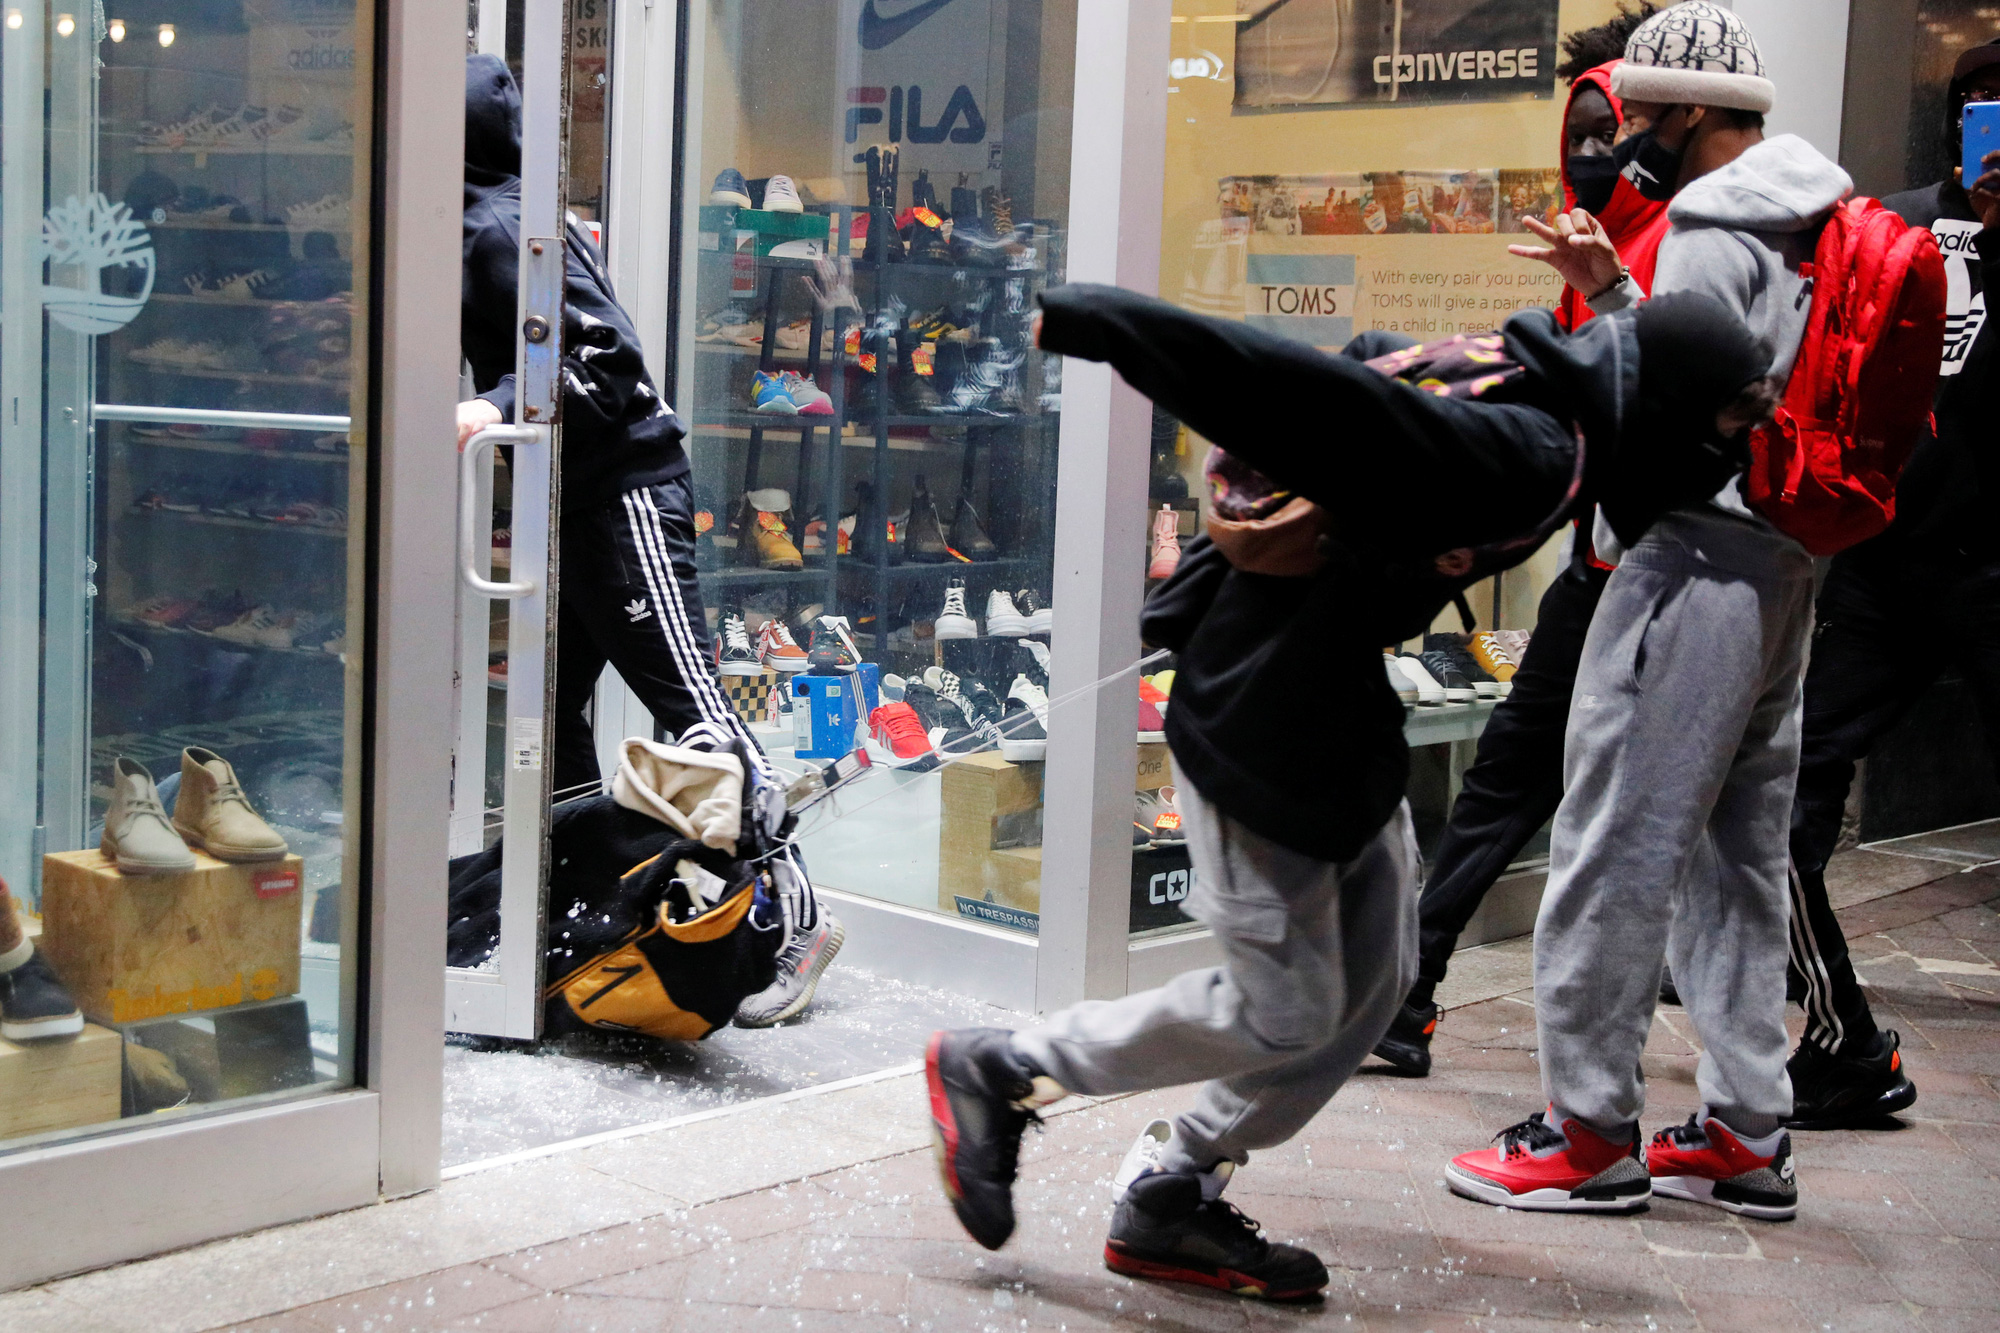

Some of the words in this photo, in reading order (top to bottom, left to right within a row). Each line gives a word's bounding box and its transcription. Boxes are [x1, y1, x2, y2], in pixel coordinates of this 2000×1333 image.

[1373, 48, 1538, 83] CONVERSE
[844, 85, 987, 144] FILA
[1372, 270, 1405, 285] With
[1409, 273, 1448, 287] every
[1453, 272, 1481, 288] pair
[1486, 274, 1513, 288] you
[1261, 286, 1337, 315] TOMS
[1371, 293, 1413, 308] TOMS
[1417, 295, 1441, 309] will
[1445, 296, 1475, 312] give
[1479, 298, 1488, 310] a
[1493, 296, 1522, 311] pair
[1526, 295, 1543, 308] of
[1546, 298, 1561, 310] ne
[1371, 319, 1386, 332] to
[1390, 321, 1399, 332] a
[1403, 318, 1436, 333] child
[1441, 319, 1454, 333] in
[1458, 320, 1495, 334] need
[1137, 761, 1162, 776] One
[960, 902, 976, 915] NO
